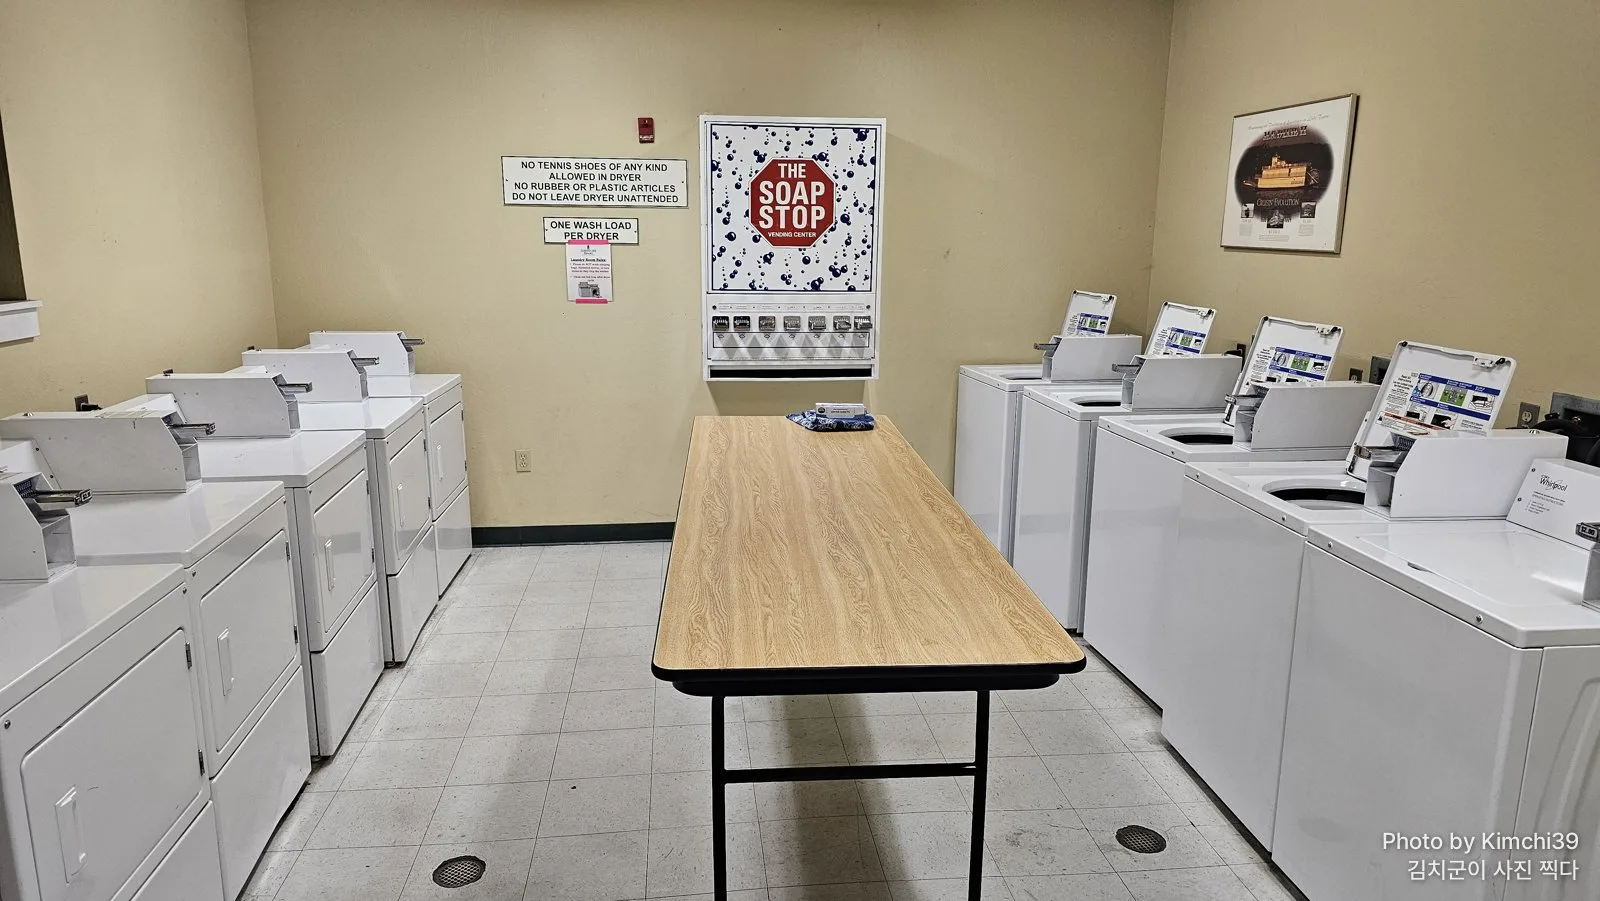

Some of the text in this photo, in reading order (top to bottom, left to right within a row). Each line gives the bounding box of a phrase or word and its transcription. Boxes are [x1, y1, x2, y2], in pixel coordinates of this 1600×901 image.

[521, 161, 668, 171] NO TENNIS SHOES OF ANY KIND
[778, 163, 806, 179] THE
[549, 172, 641, 181] ALLOWED IN DRYER
[514, 182, 676, 192] NO RUBBER OR PLASTIC ARTICLES
[759, 180, 826, 205] SOAP
[512, 193, 679, 203] DO NOT LEAVE DRYER UNATTENDED
[759, 205, 826, 229] STOP
[550, 221, 632, 230] ONE WASH LOAD
[564, 232, 619, 240] PER DRYER
[1540, 478, 1568, 491] Whirlpool
